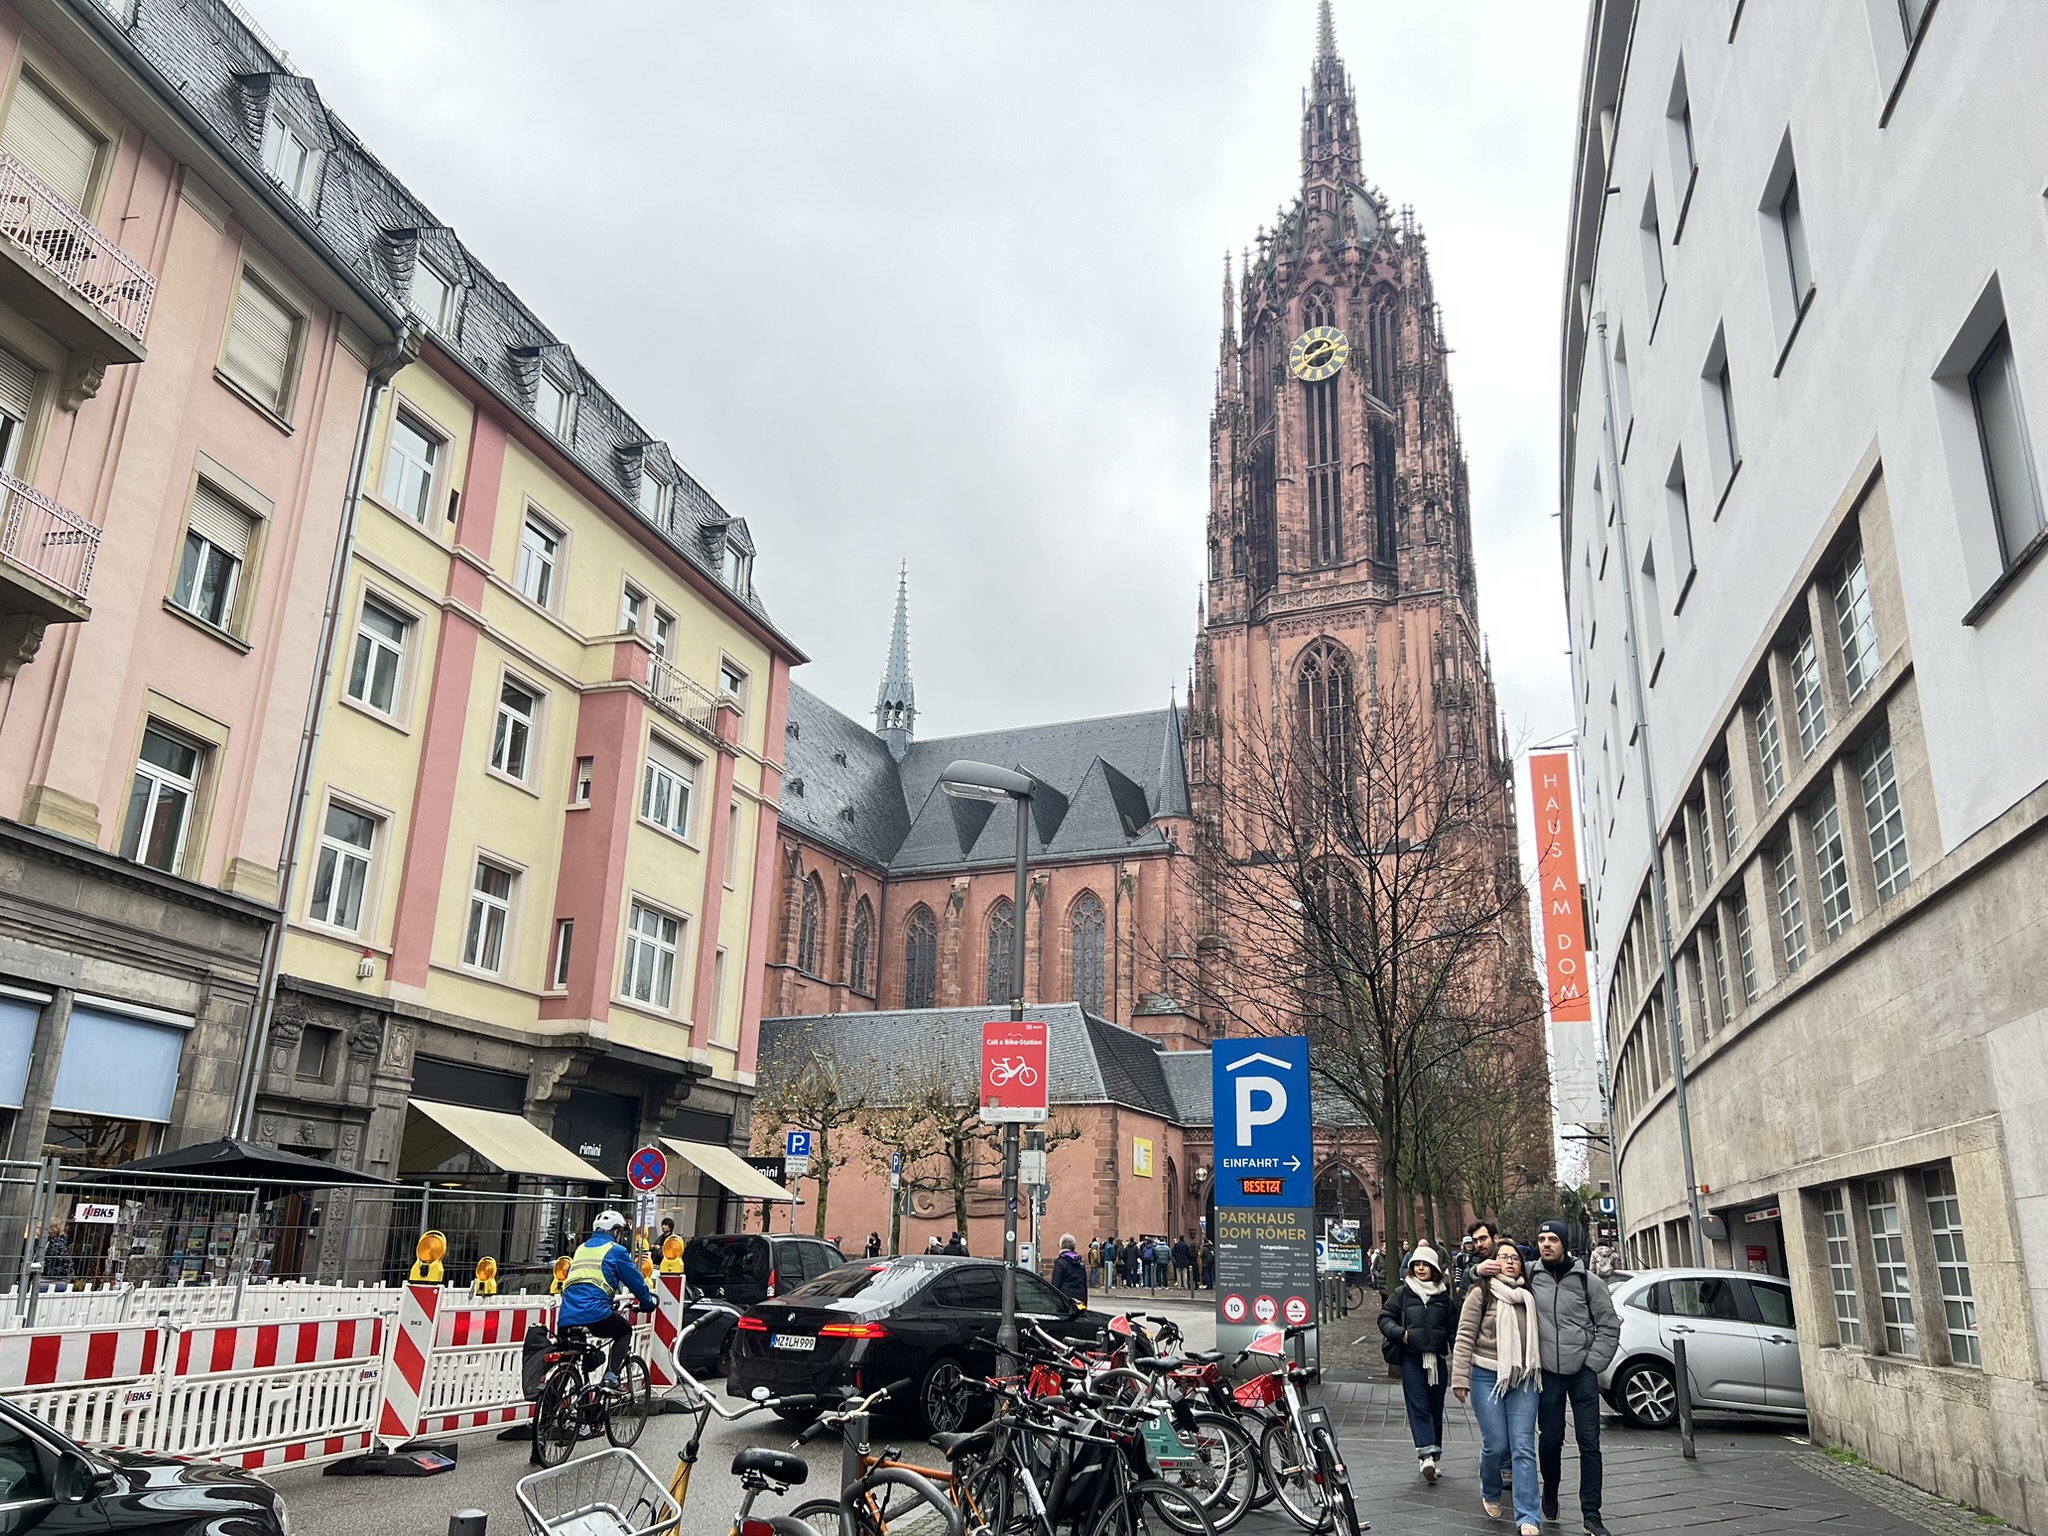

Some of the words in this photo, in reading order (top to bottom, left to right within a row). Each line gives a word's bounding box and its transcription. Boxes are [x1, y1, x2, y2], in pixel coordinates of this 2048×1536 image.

[1543, 773, 1562, 858] HAUS
[1552, 875, 1572, 915] AM
[1558, 933, 1579, 999] DOM
[1236, 1076, 1288, 1146] P
[580, 1142, 601, 1156] rimini
[792, 1134, 805, 1152] P
[893, 1155, 899, 1171] P
[1223, 1158, 1279, 1168] EINFAHRT
[1244, 1180, 1281, 1192] BESETZT
[1600, 1198, 1614, 1213] U
[1220, 1212, 1296, 1224] PARKHAUS
[1220, 1227, 1251, 1239] DOM
[1256, 1226, 1306, 1240] RÖMER
